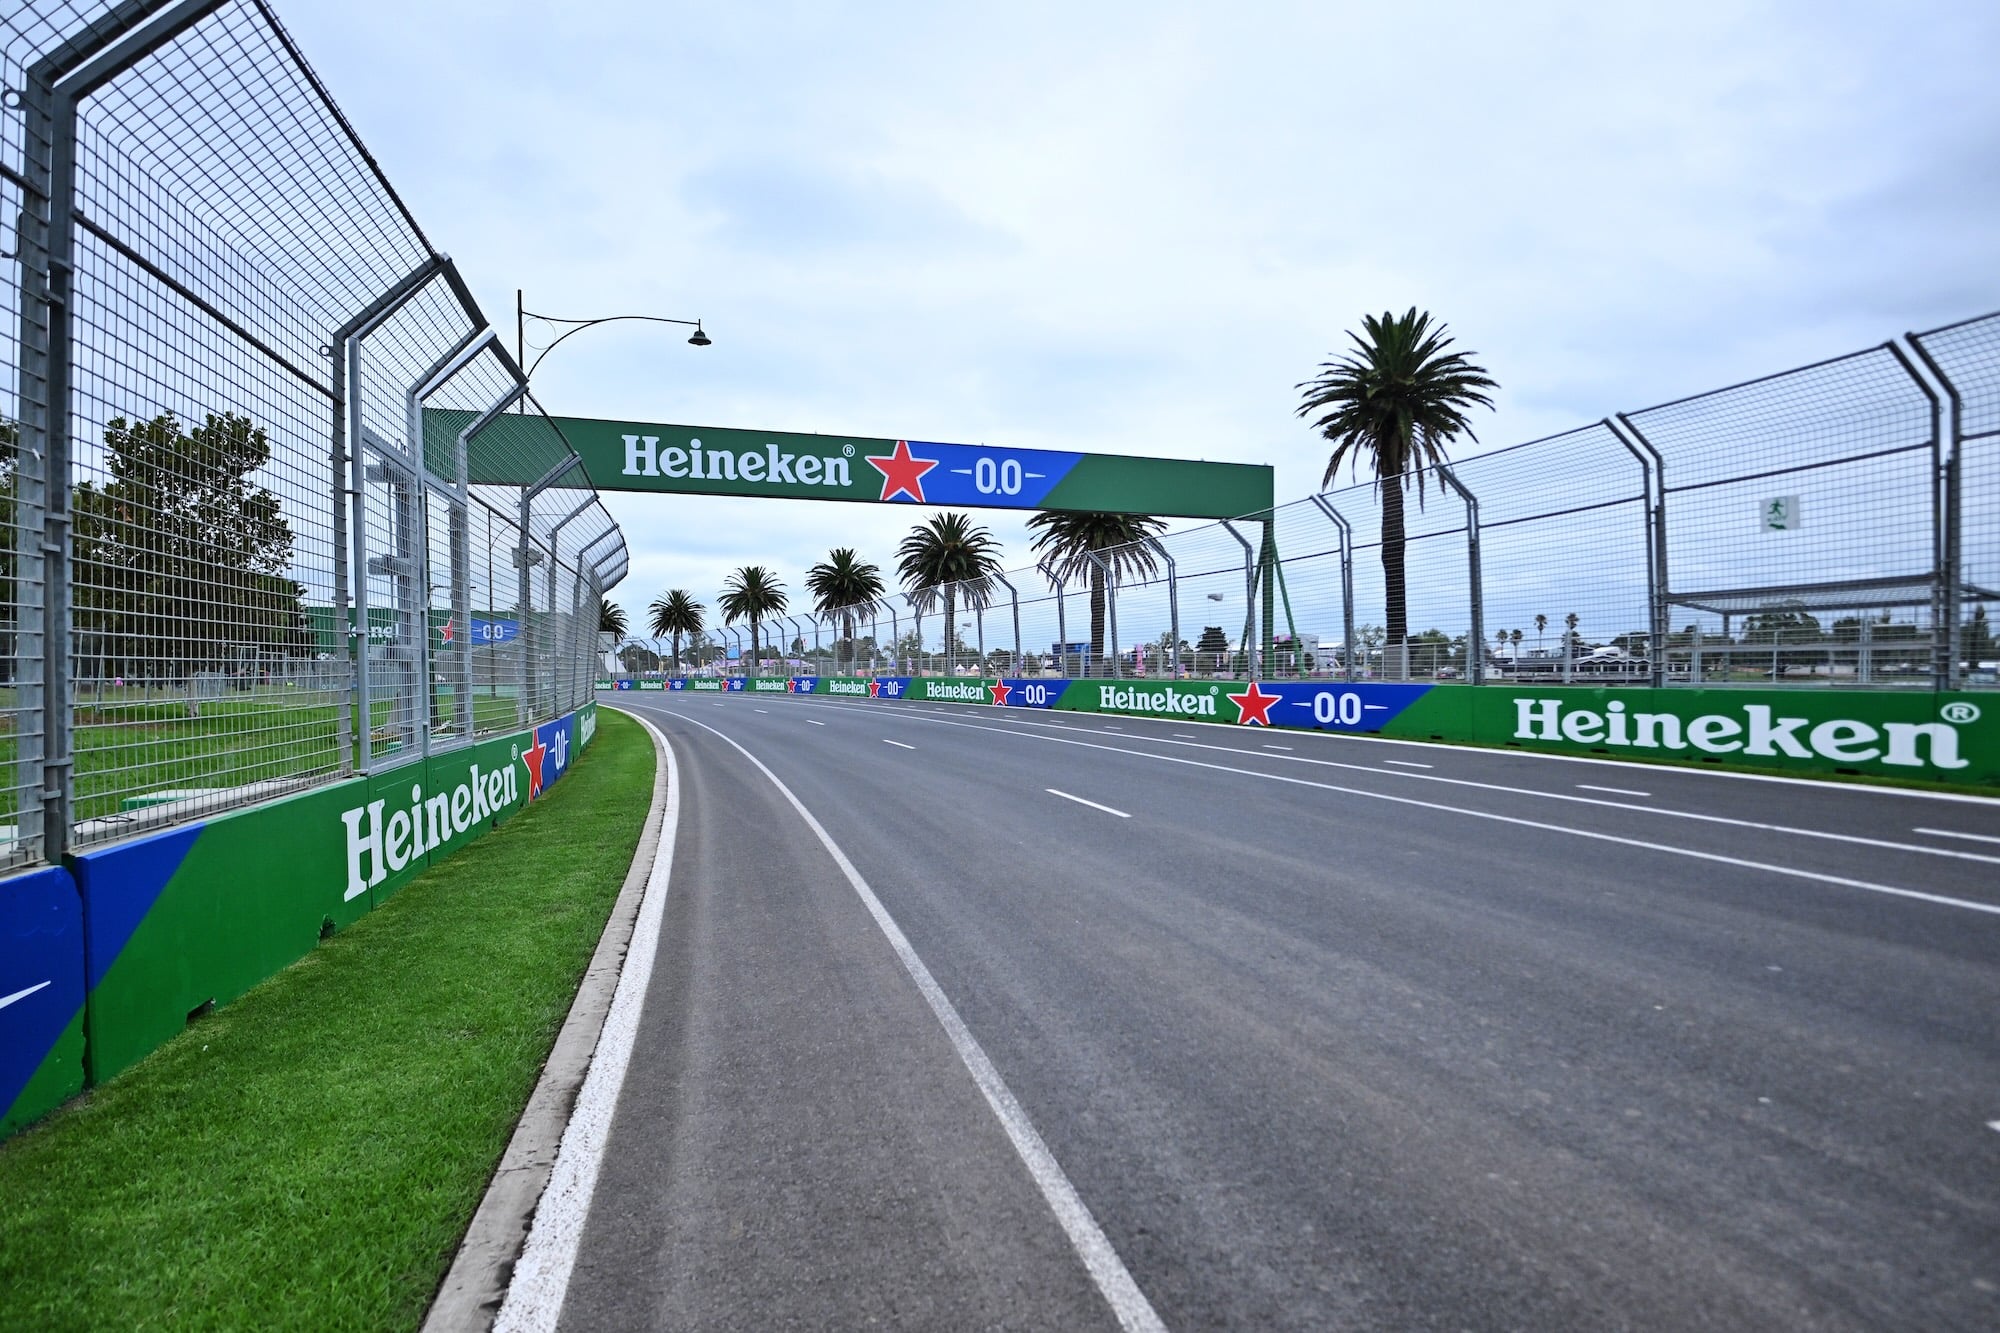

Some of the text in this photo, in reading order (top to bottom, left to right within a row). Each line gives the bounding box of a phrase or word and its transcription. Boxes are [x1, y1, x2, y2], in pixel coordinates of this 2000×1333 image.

[975, 457, 1022, 495] 0.0
[1025, 684, 1046, 705] 0.0
[1314, 692, 1361, 725] 0.0
